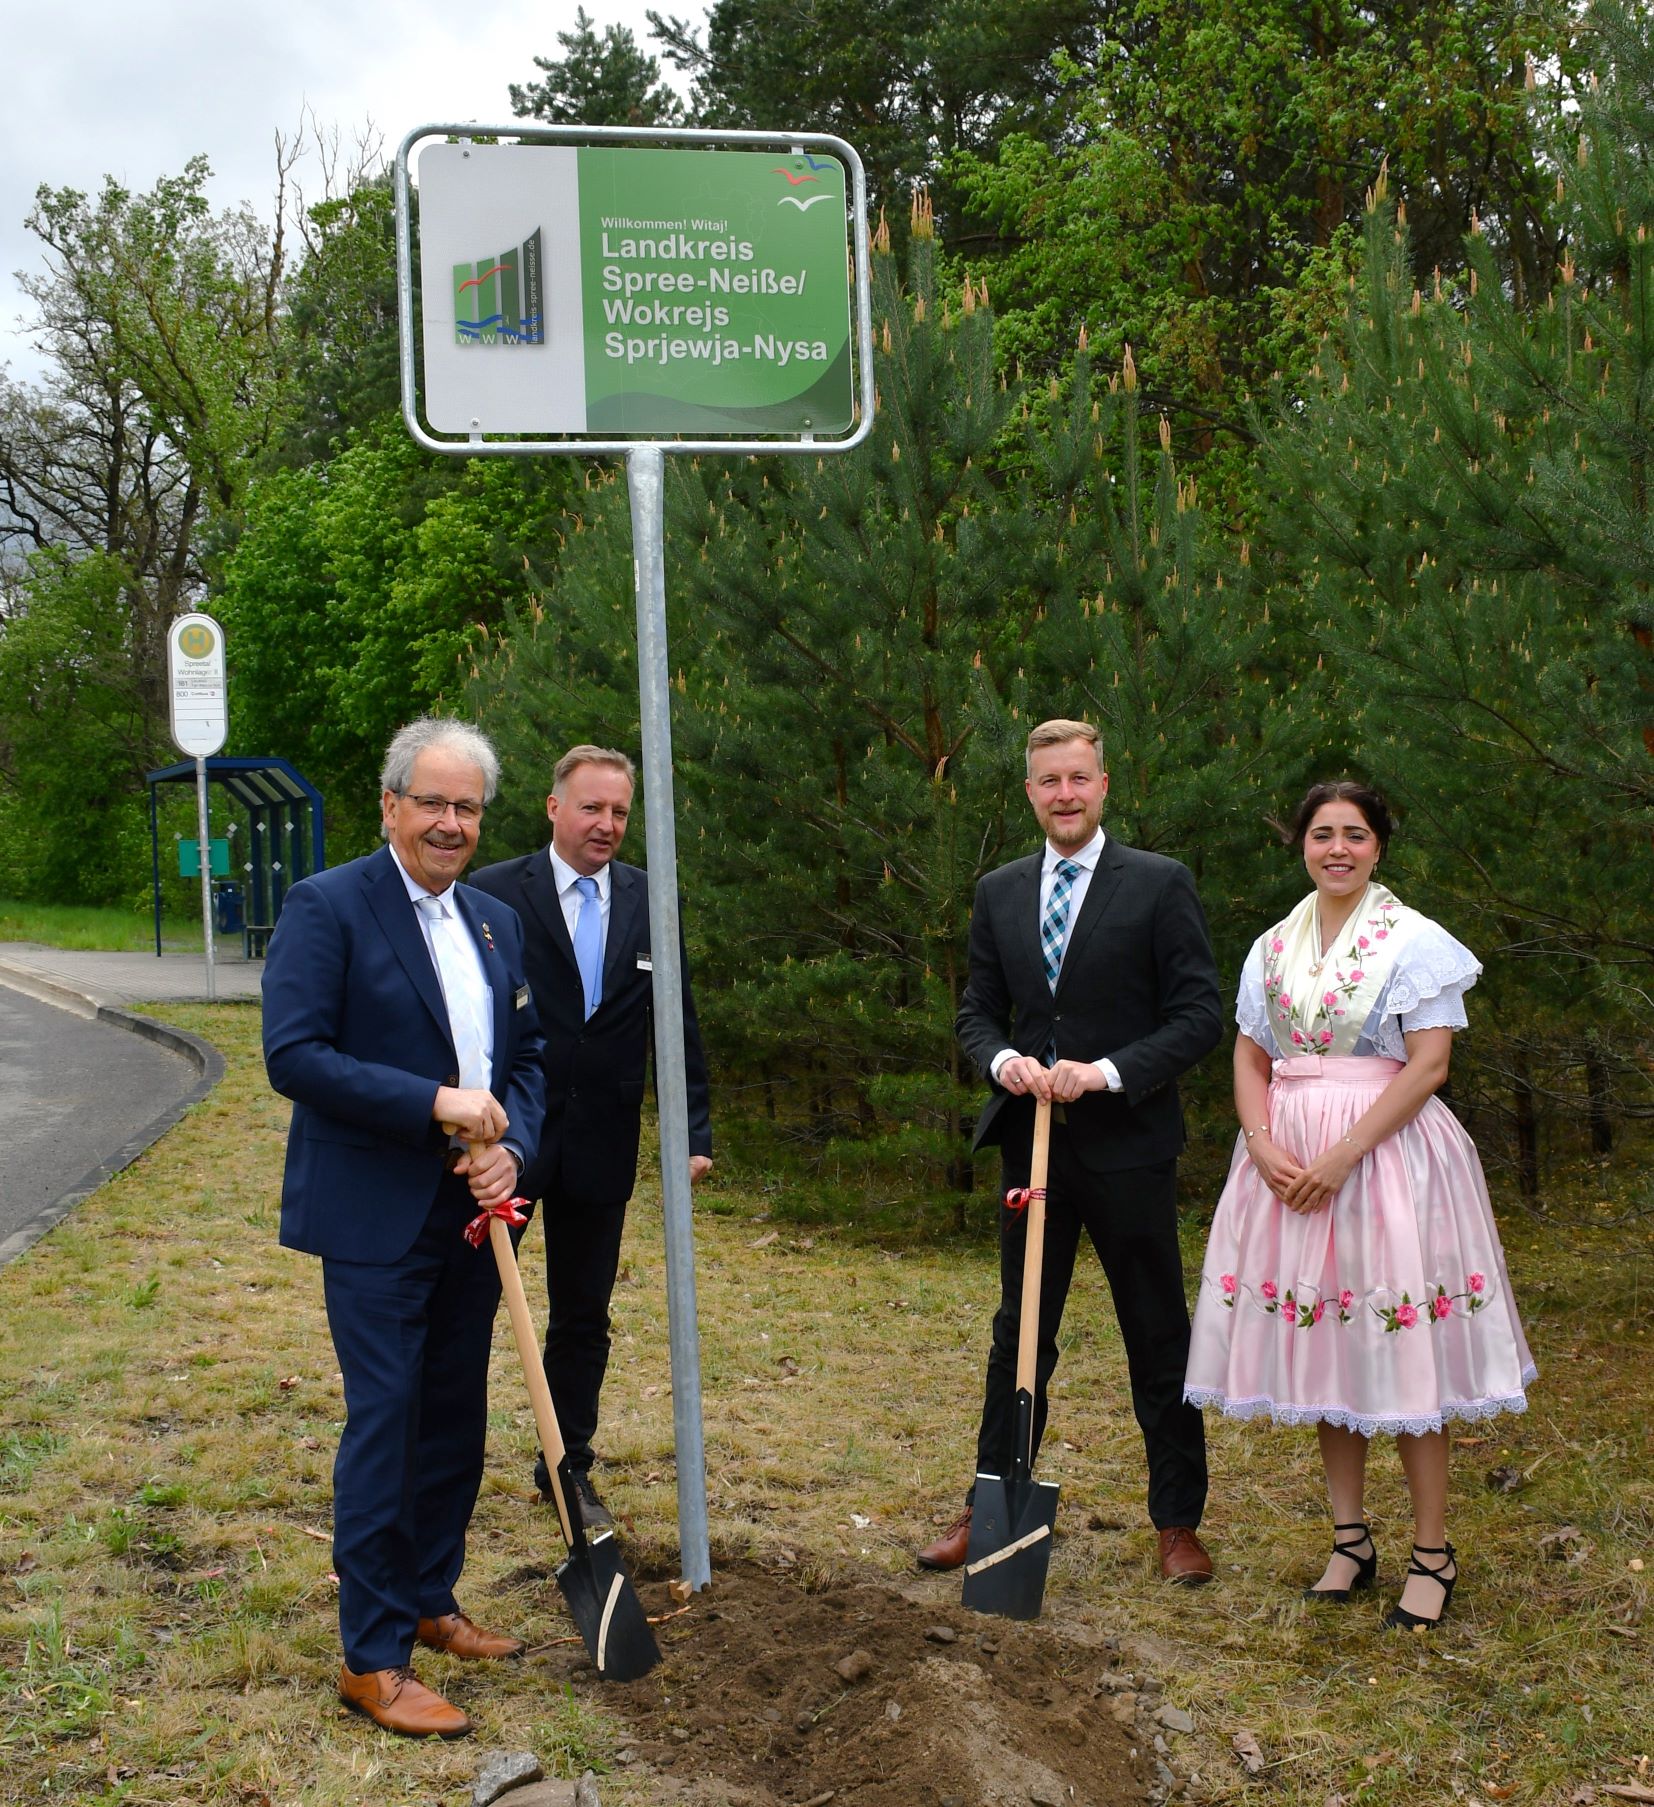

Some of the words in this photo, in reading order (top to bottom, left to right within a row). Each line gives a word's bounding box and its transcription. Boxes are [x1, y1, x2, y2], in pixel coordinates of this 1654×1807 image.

[601, 217, 687, 229] Willkommen!
[691, 219, 728, 233] Witaj!
[602, 233, 754, 261] Landkreis
[528, 240, 538, 343] landkreis-spree-neisse.de
[602, 265, 806, 297] Spree-Neiße/
[602, 299, 730, 332] Wokrejs
[605, 332, 827, 366] Sprjewja-Nysa
[188, 631, 205, 647] H
